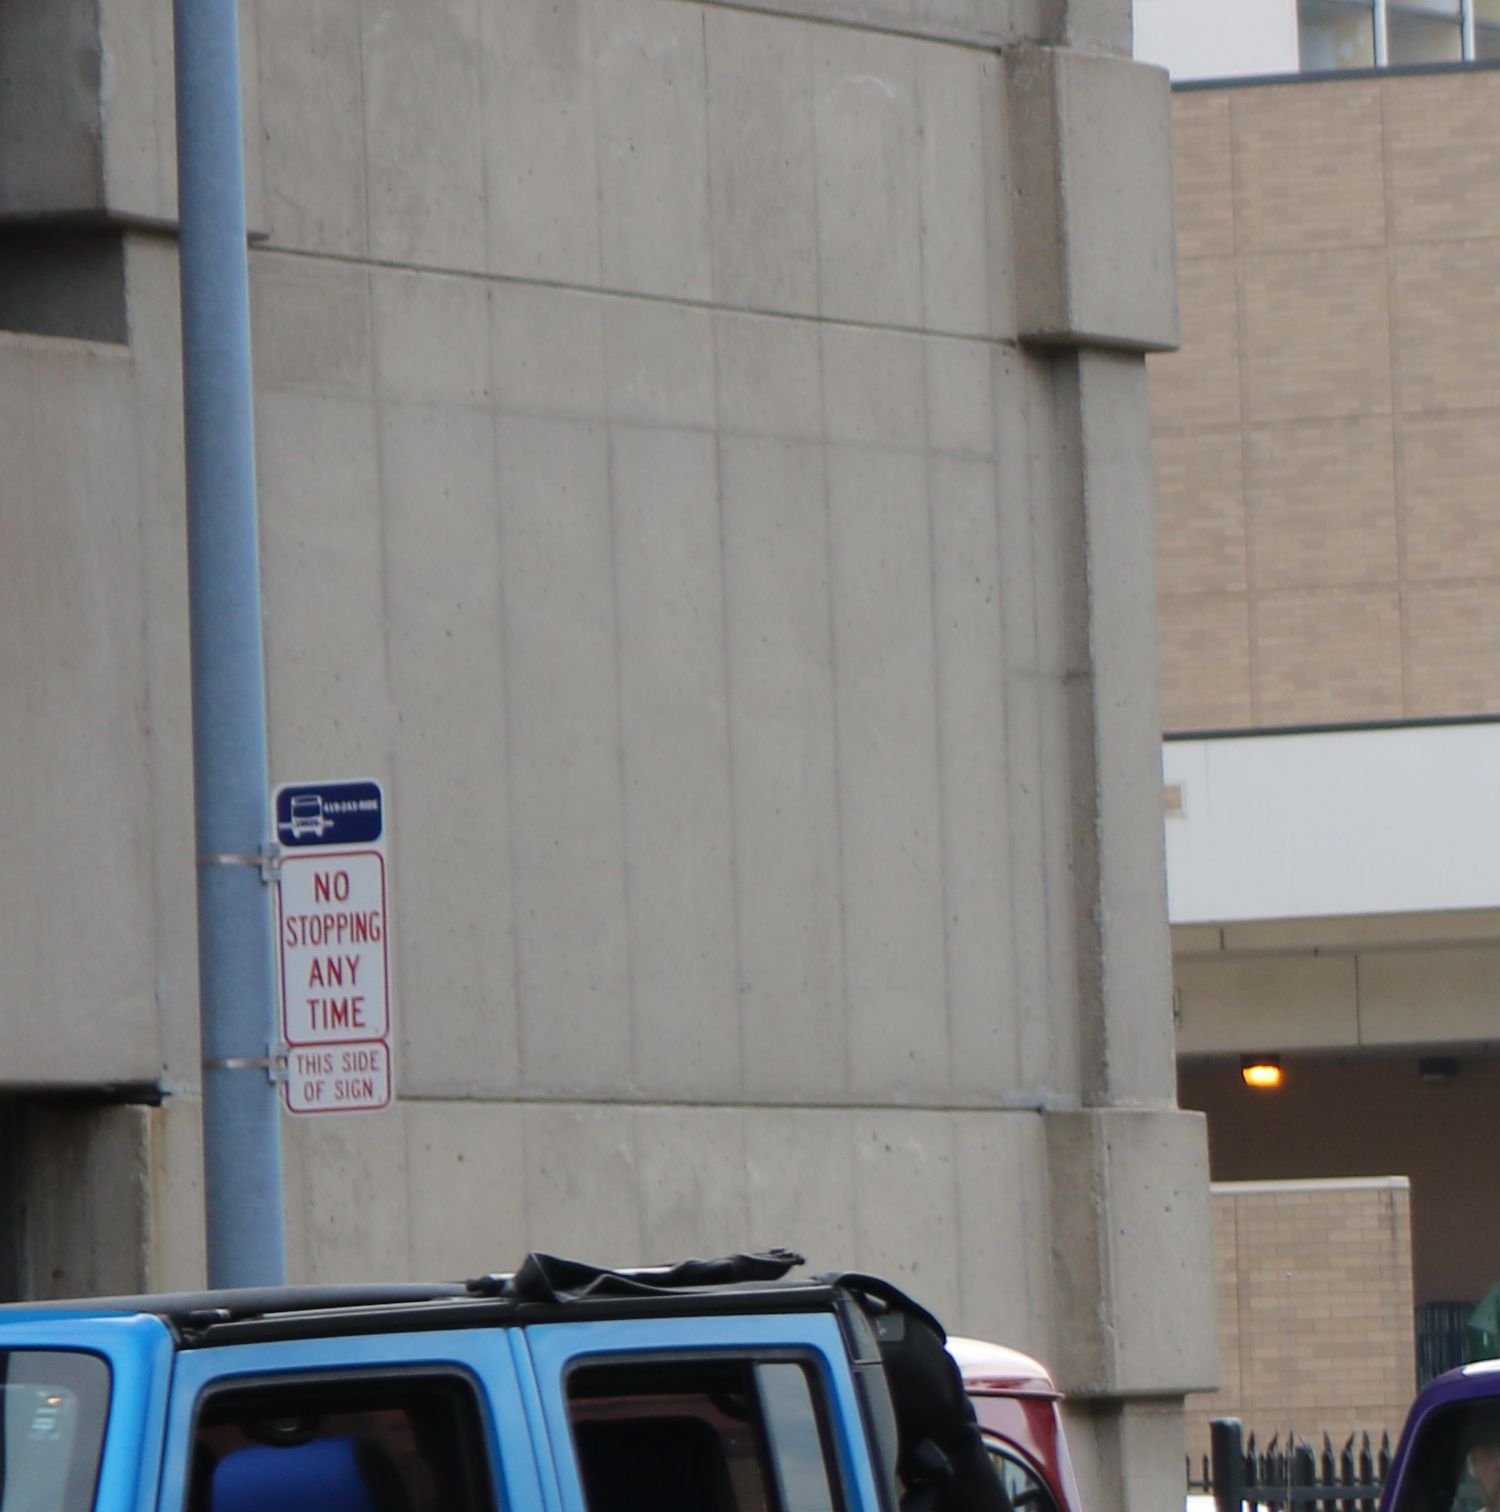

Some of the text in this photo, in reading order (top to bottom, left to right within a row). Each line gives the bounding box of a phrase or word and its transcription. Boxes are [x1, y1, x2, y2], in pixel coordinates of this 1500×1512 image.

[314, 871, 350, 903] NO
[286, 911, 381, 947] STOPPING
[308, 955, 361, 988] ANY
[306, 996, 367, 1030] TIME
[296, 1050, 380, 1076] THIS SIDE
[303, 1078, 374, 1102] OF SIGN
